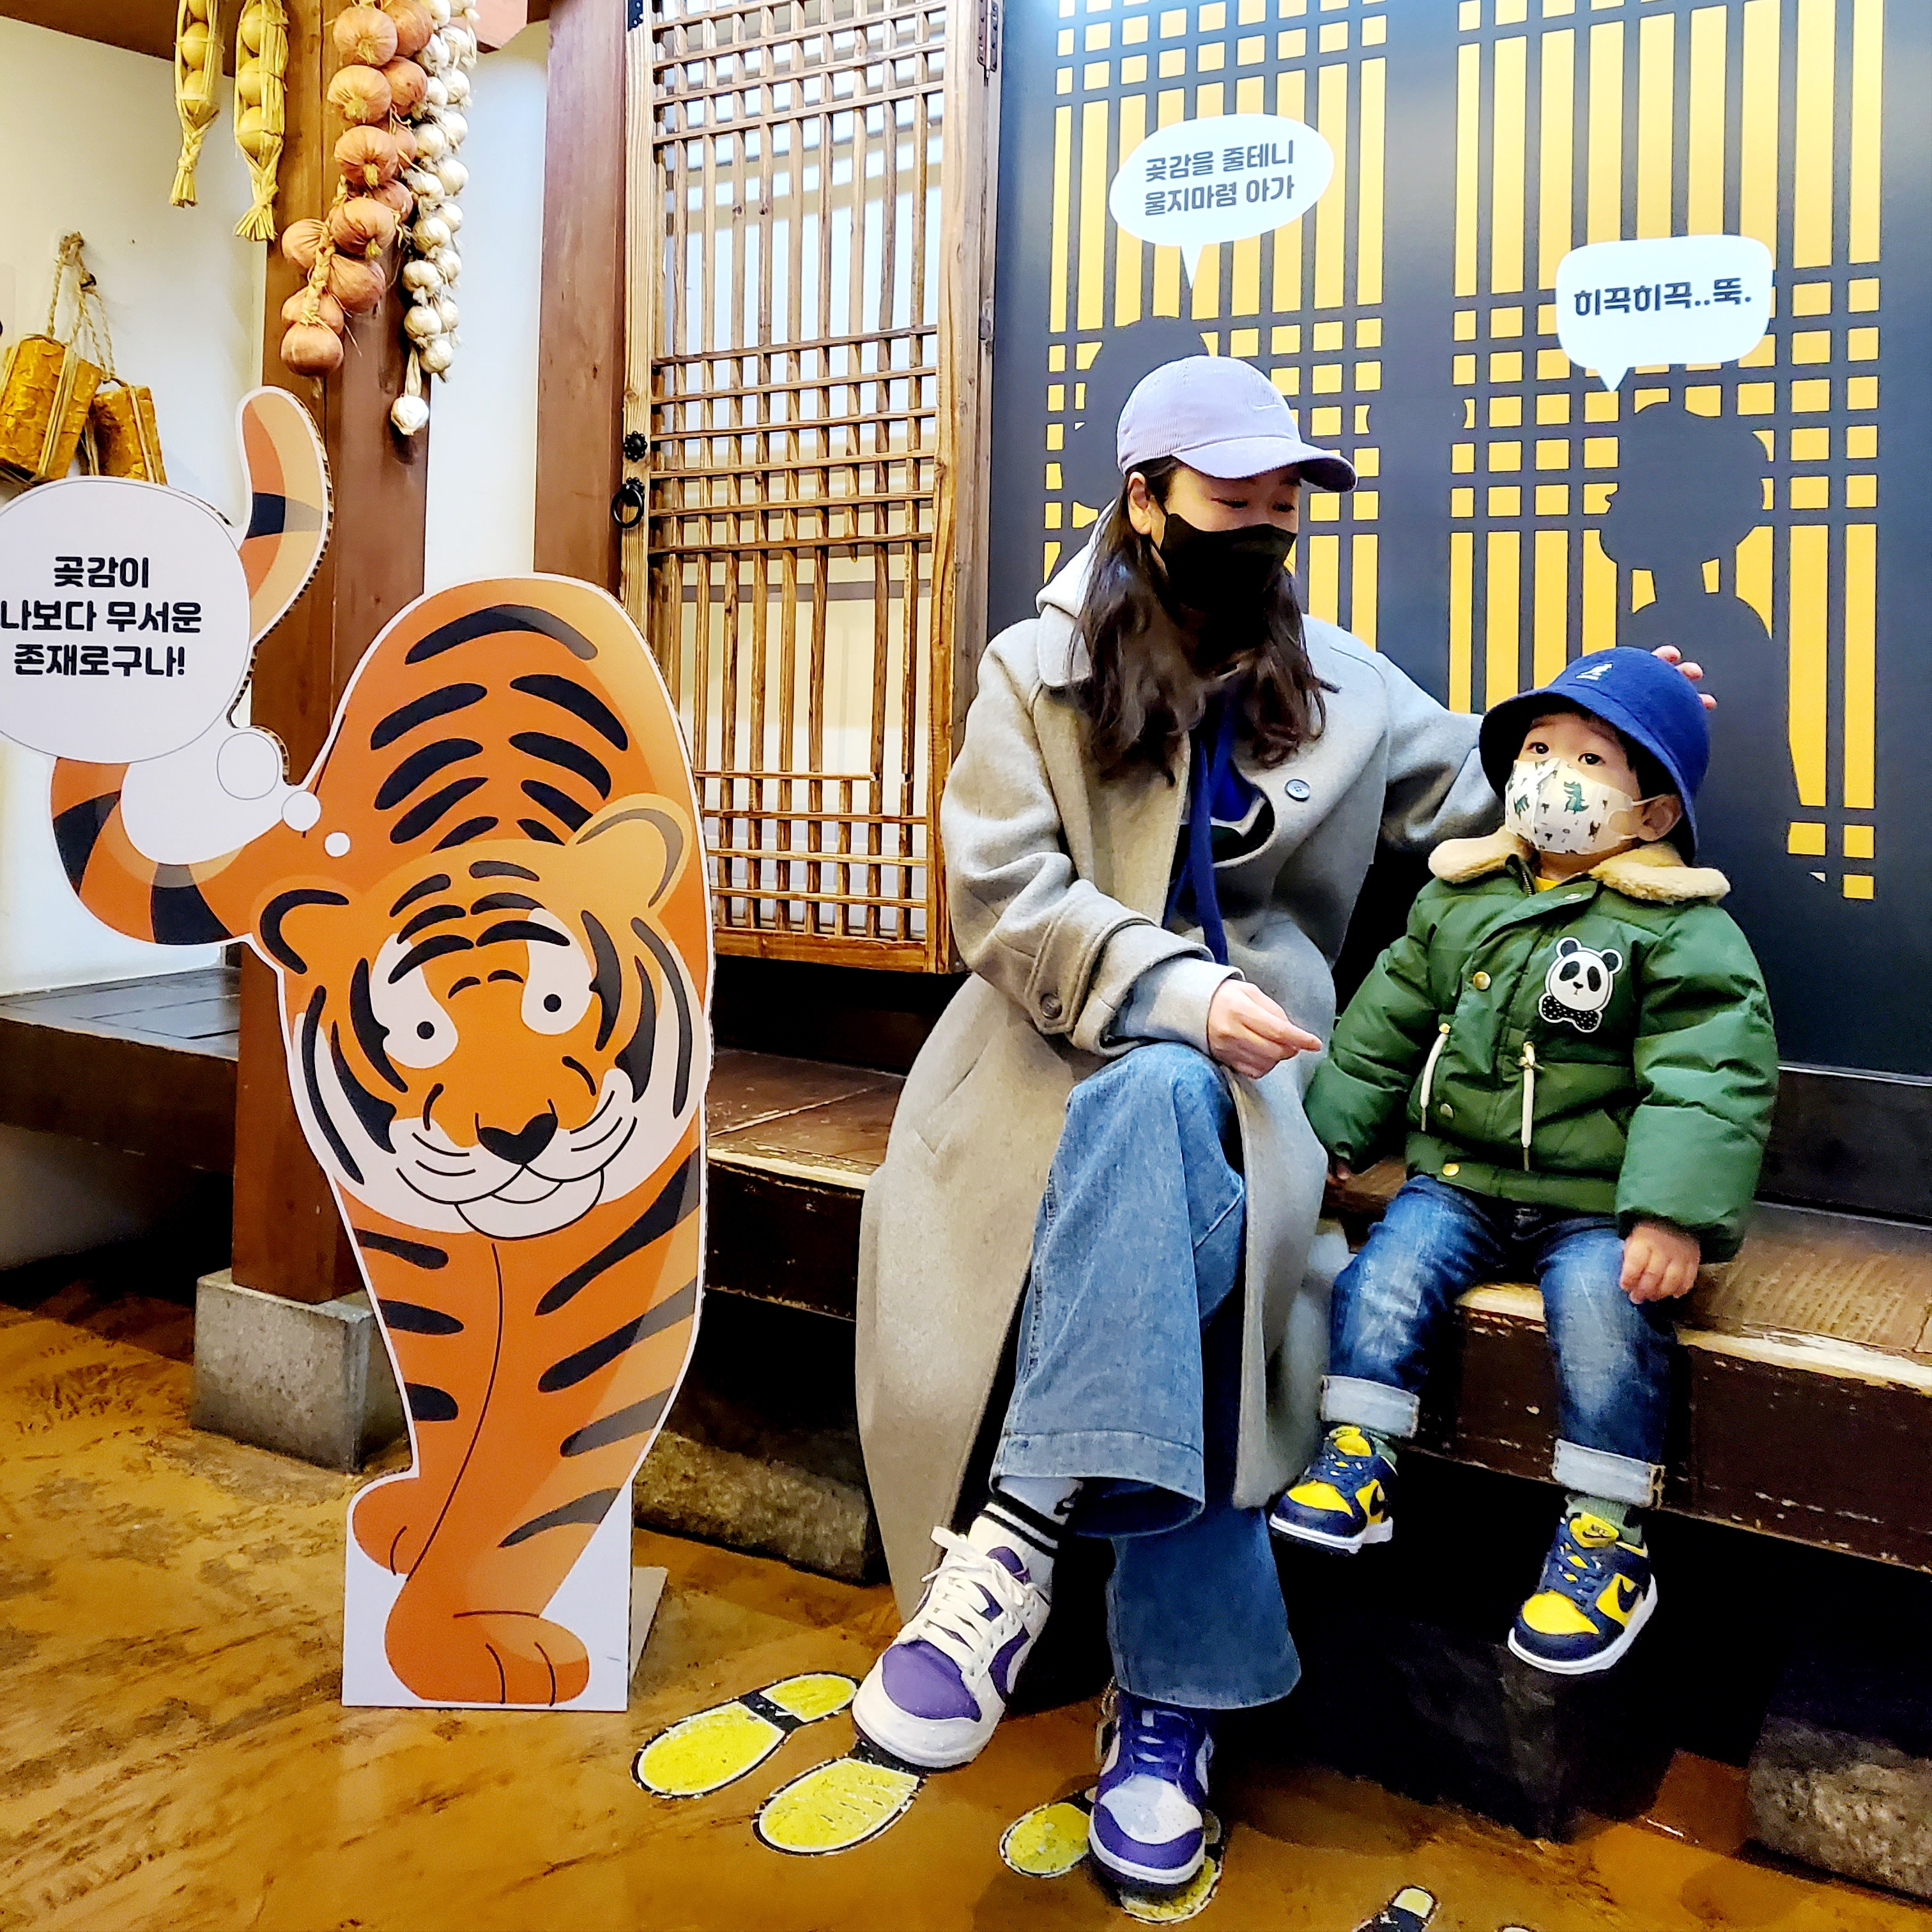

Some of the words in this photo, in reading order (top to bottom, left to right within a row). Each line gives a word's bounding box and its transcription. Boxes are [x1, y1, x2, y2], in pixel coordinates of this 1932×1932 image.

[1146, 151, 1214, 182] 곶감을
[1222, 139, 1294, 172] 줄테니
[1145, 181, 1237, 216] 울지마렴
[1246, 174, 1294, 203] 아가
[54, 556, 149, 588] 곶감이
[0, 600, 97, 631] 나보다
[107, 602, 201, 632] 무서운
[14, 643, 185, 677] 존재로구나!
